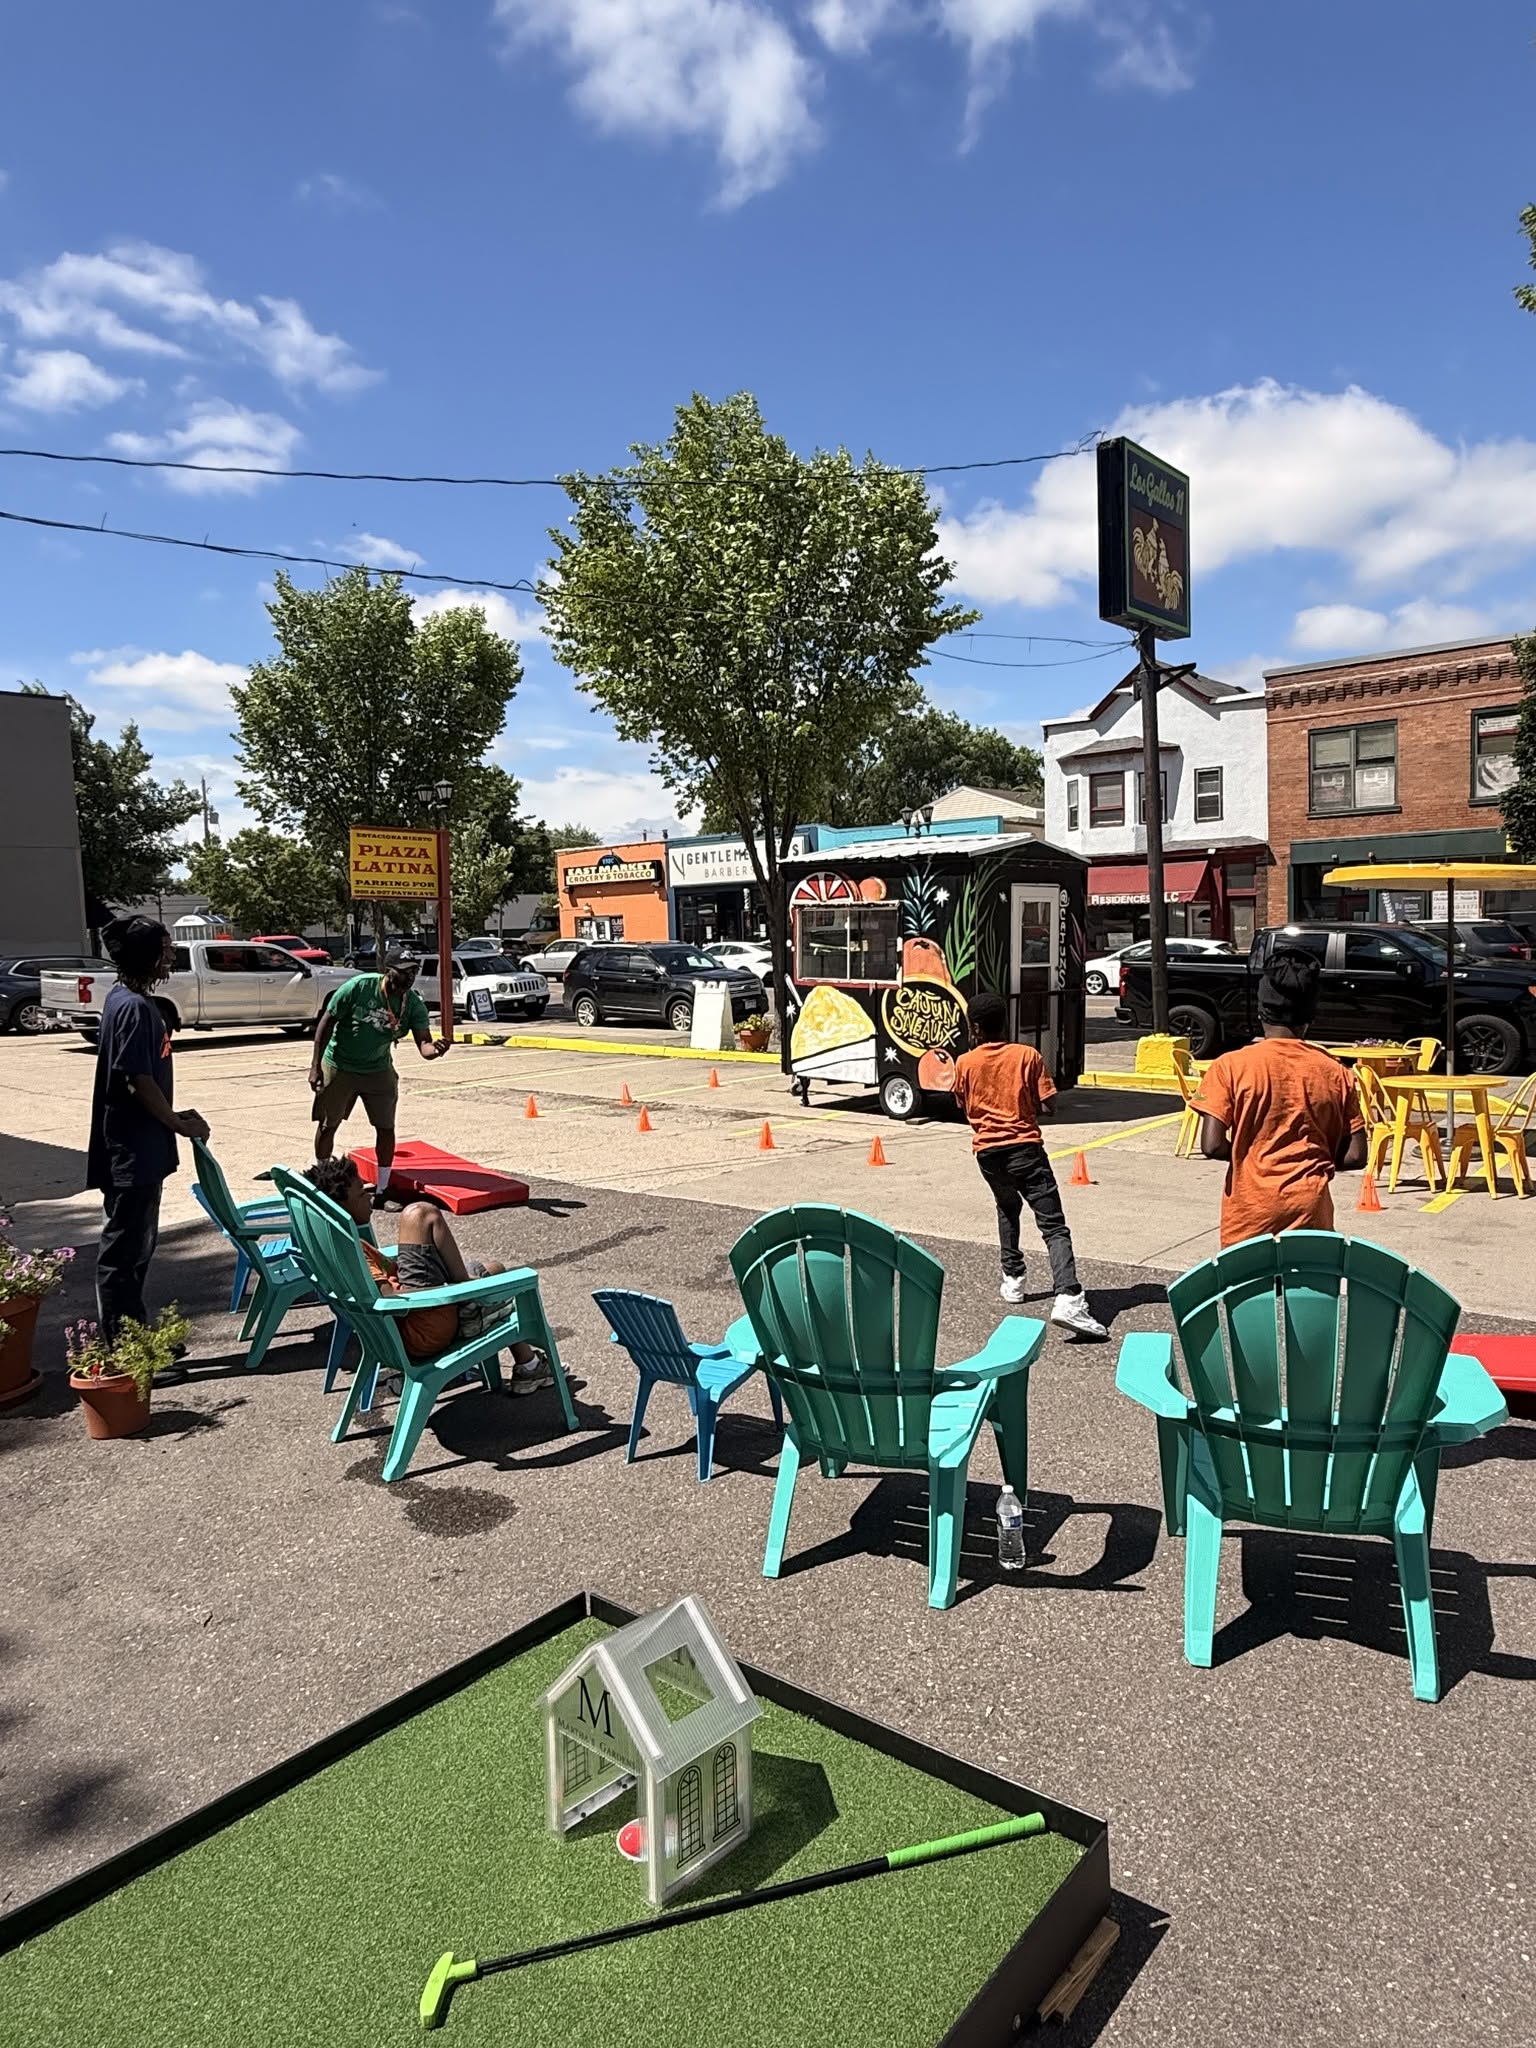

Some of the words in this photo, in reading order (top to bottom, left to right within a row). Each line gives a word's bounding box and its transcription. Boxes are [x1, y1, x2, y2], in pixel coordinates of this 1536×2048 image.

[1130, 463, 1146, 495] Los
[1147, 472, 1175, 510] Gallos
[356, 833, 433, 842] ESTACIONAMIENTO
[358, 844, 431, 859] PLAZA
[352, 860, 436, 875] LATINA
[567, 866, 598, 876] EAST
[598, 862, 653, 874] MARKET
[613, 870, 652, 880] TOBACCO
[355, 880, 410, 888] PARKING
[1091, 894, 1150, 905] RESIDENCES
[896, 987, 959, 1027] CAJUN
[576, 1675, 615, 1739] M
